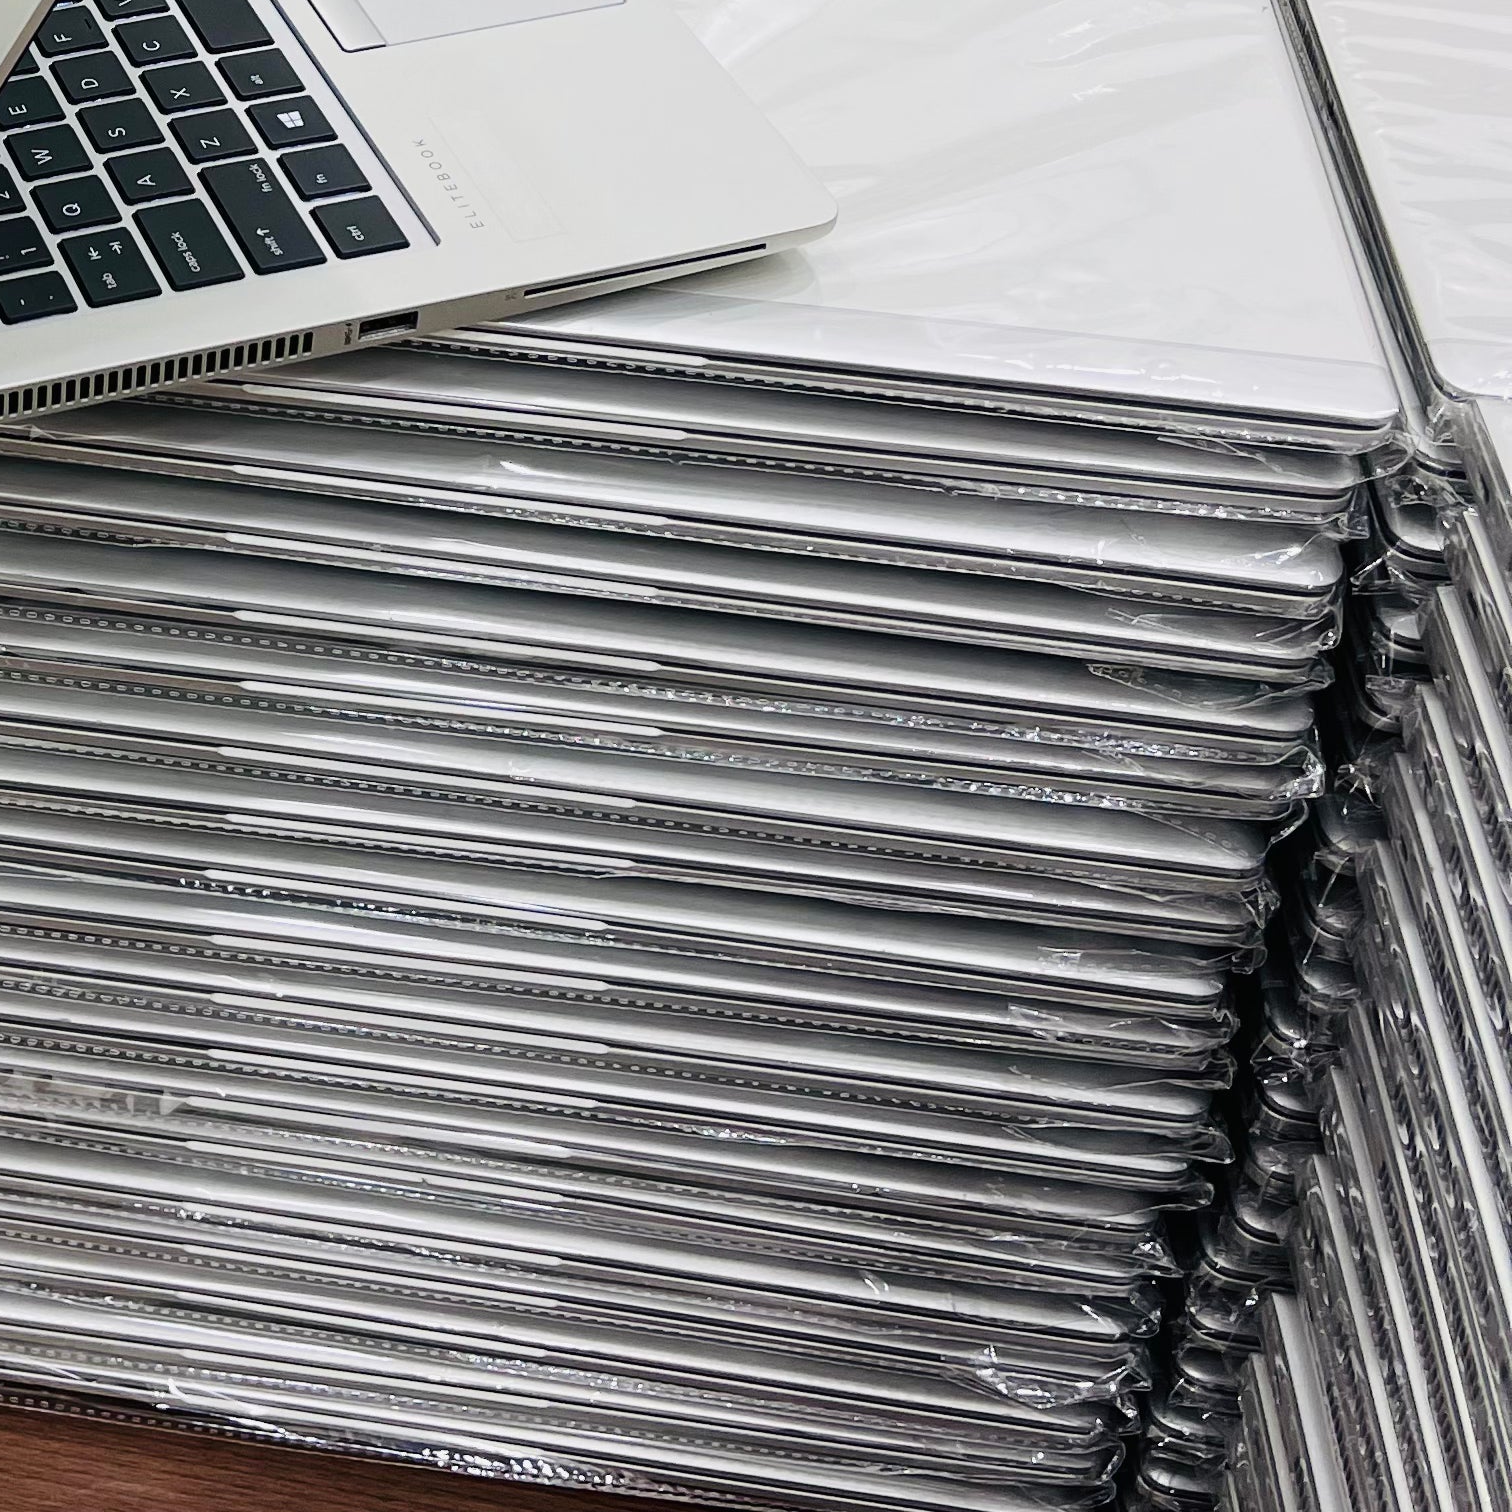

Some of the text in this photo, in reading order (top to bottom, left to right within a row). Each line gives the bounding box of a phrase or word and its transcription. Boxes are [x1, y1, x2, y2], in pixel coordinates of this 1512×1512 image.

[53, 33, 72, 43] F
[143, 40, 161, 52] C
[81, 78, 99, 89] D
[170, 87, 190, 99] X
[8, 104, 28, 115] E
[108, 127, 126, 138] S
[199, 137, 221, 149] Z
[31, 148, 53, 165] W
[249, 163, 268, 183] lock
[137, 174, 156, 186] A
[412, 138, 485, 229] ELITEBOOK
[62, 202, 81, 216] Q
[346, 225, 365, 241] ctrl
[20, 247, 37, 255] 1
[170, 231, 201, 273] caps lock
[102, 272, 118, 289] tab
